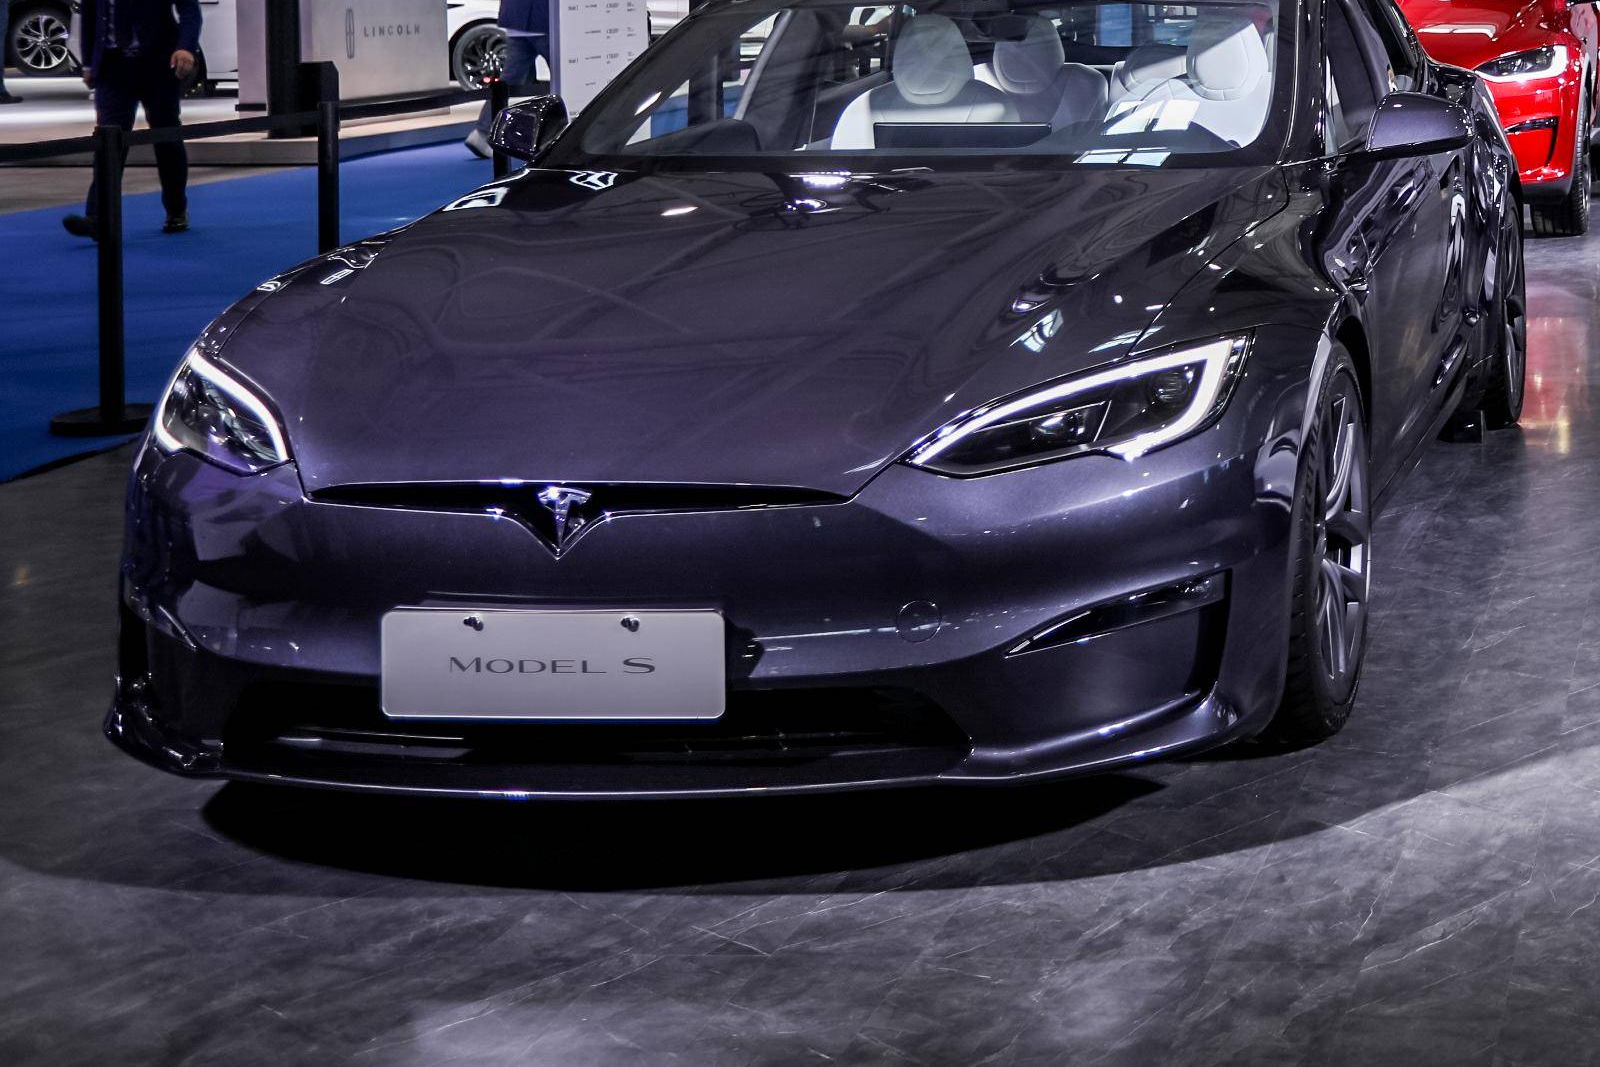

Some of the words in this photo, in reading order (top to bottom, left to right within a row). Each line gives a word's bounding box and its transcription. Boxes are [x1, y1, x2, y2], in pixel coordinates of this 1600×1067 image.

[363, 24, 421, 38] LINCOLN
[450, 656, 607, 674] MODEL
[622, 657, 656, 674] S
